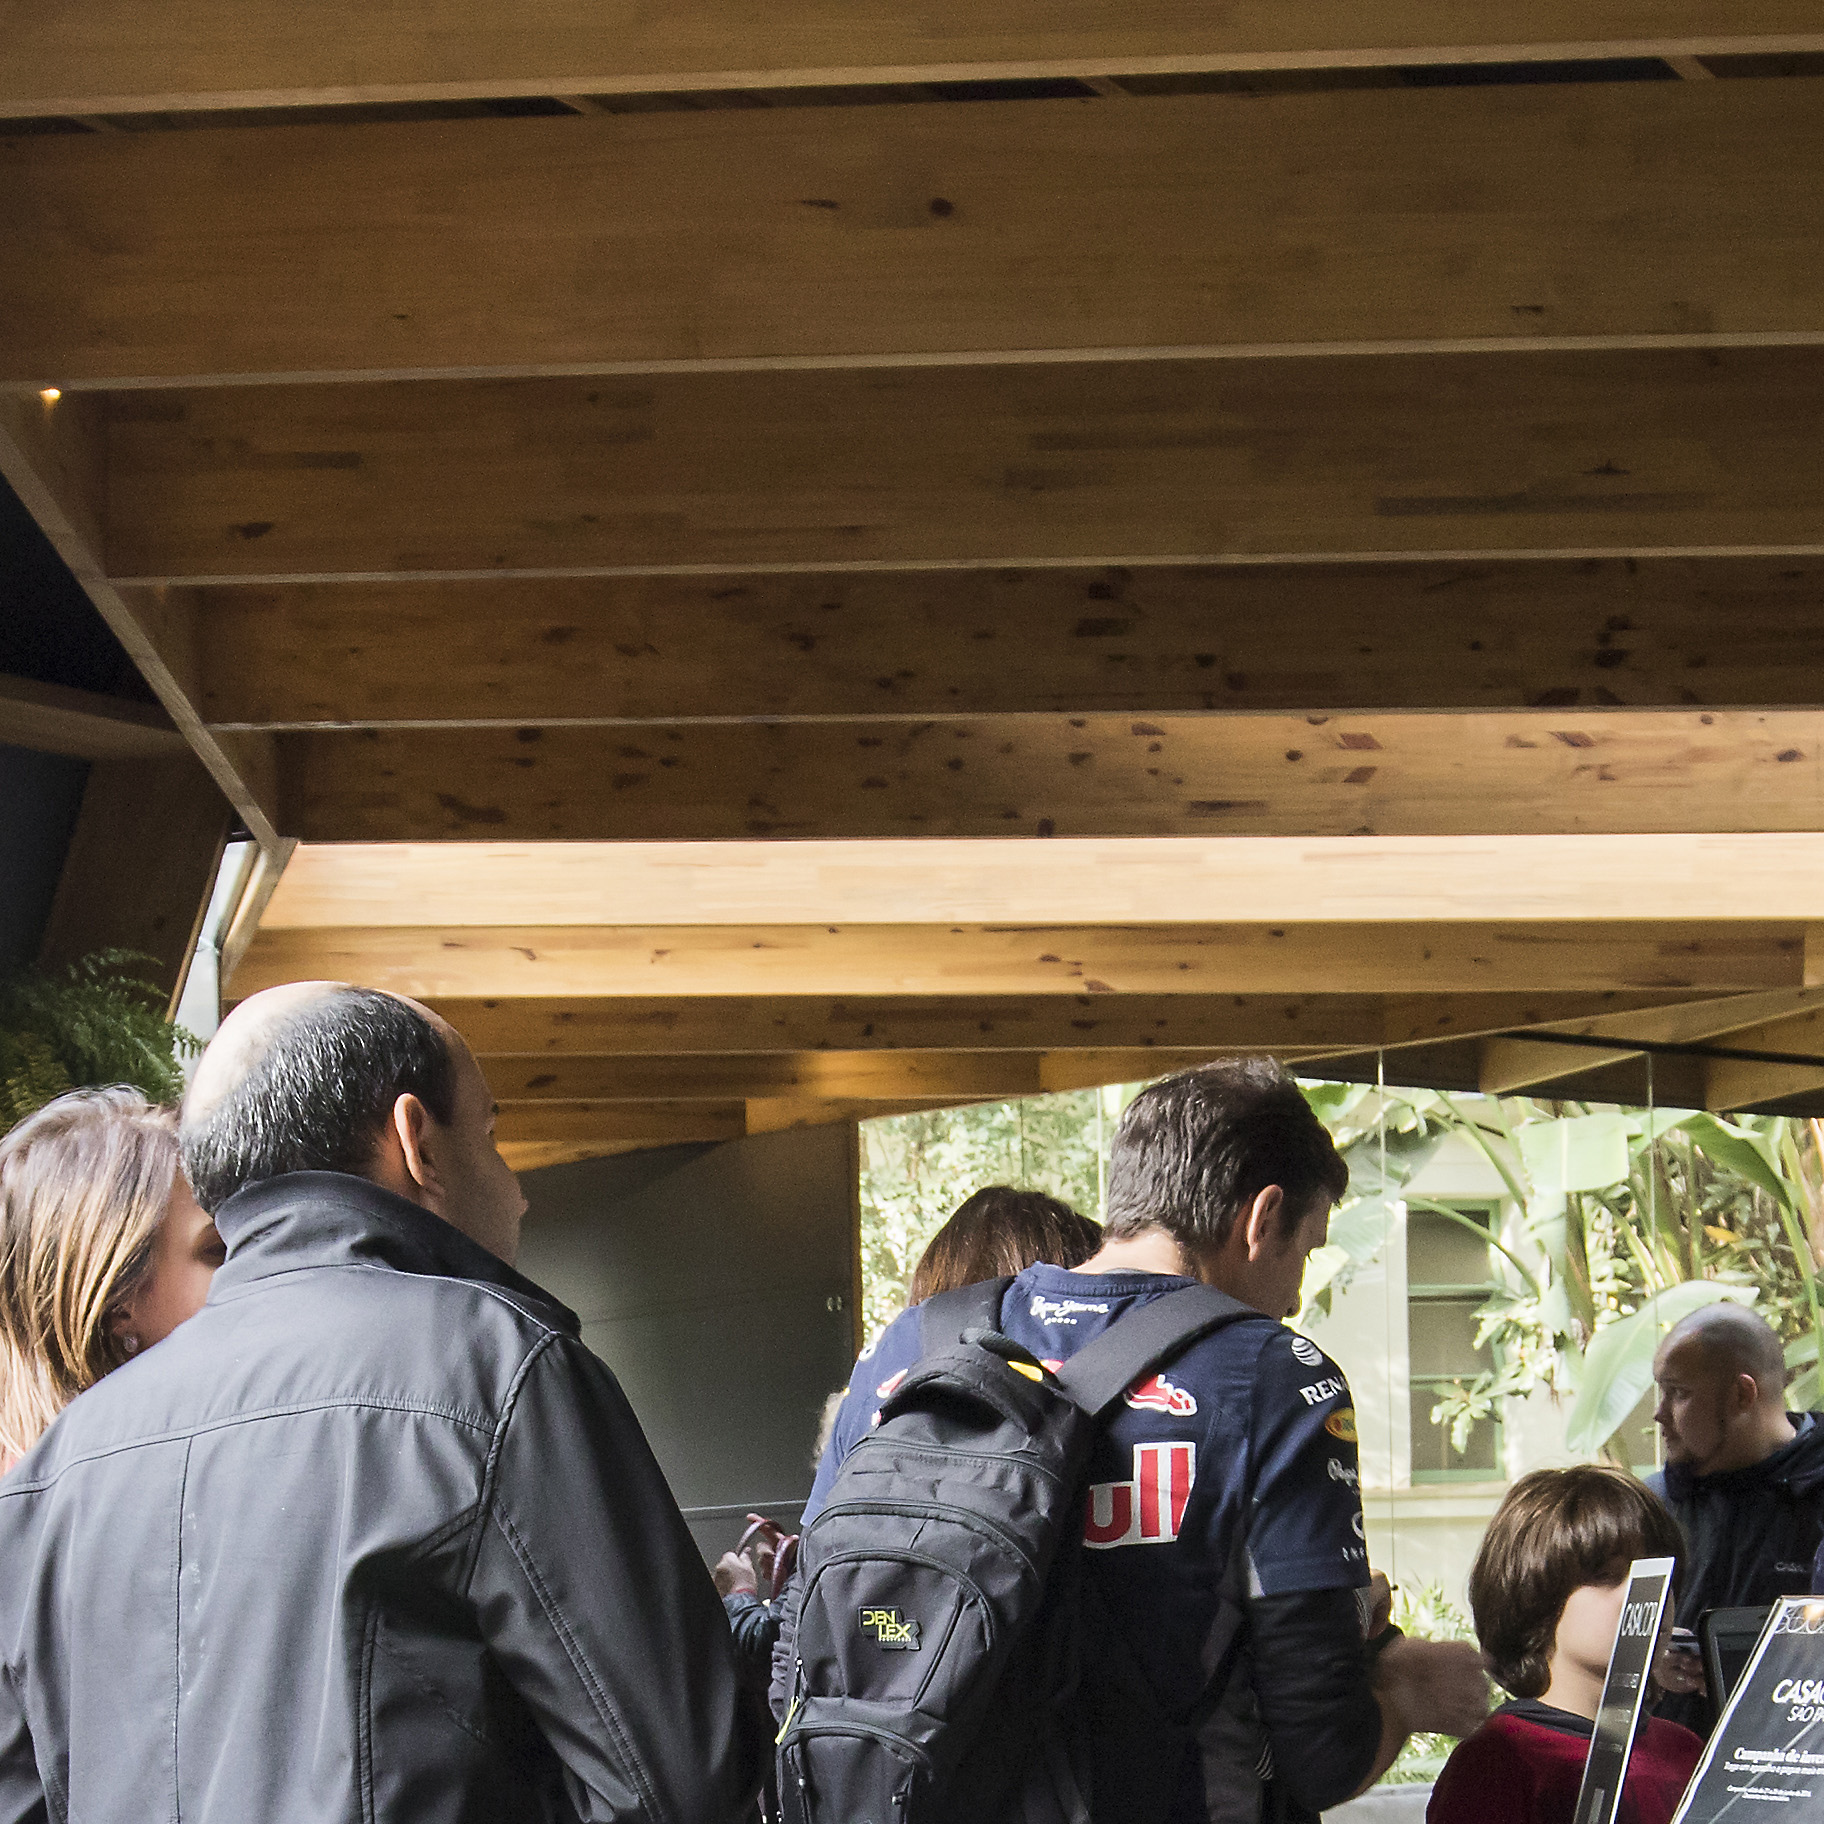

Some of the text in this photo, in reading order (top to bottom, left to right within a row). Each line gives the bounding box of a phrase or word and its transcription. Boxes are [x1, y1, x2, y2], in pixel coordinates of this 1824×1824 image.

[1083, 1441, 1196, 1550] ull
[862, 1610, 896, 1626] DEN
[878, 1623, 912, 1640] LEX
